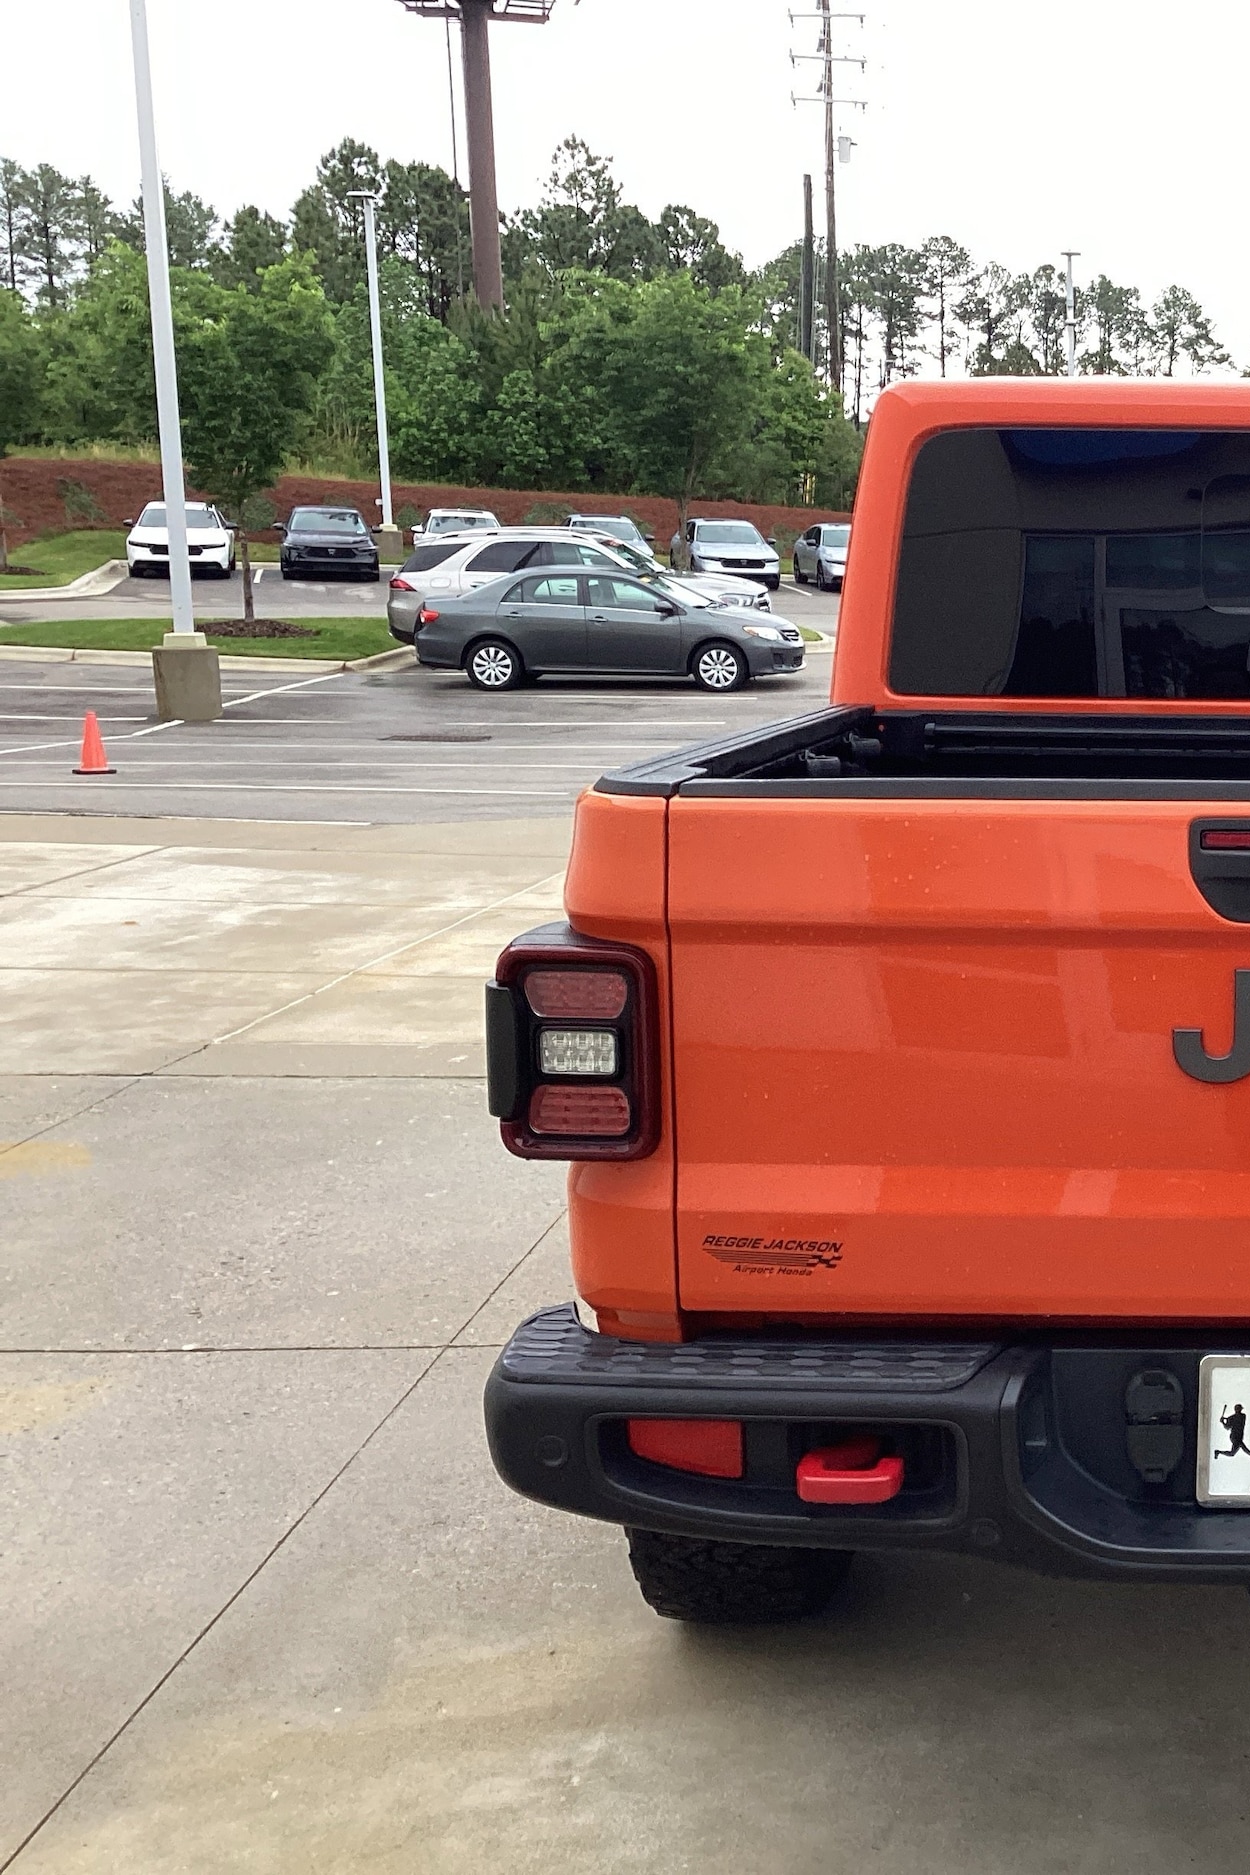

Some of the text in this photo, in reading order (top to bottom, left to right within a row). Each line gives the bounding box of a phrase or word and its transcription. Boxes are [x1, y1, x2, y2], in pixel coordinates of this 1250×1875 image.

[702, 1235, 844, 1253] REGGIE JACKSON
[732, 1264, 814, 1276] Airport Honda
